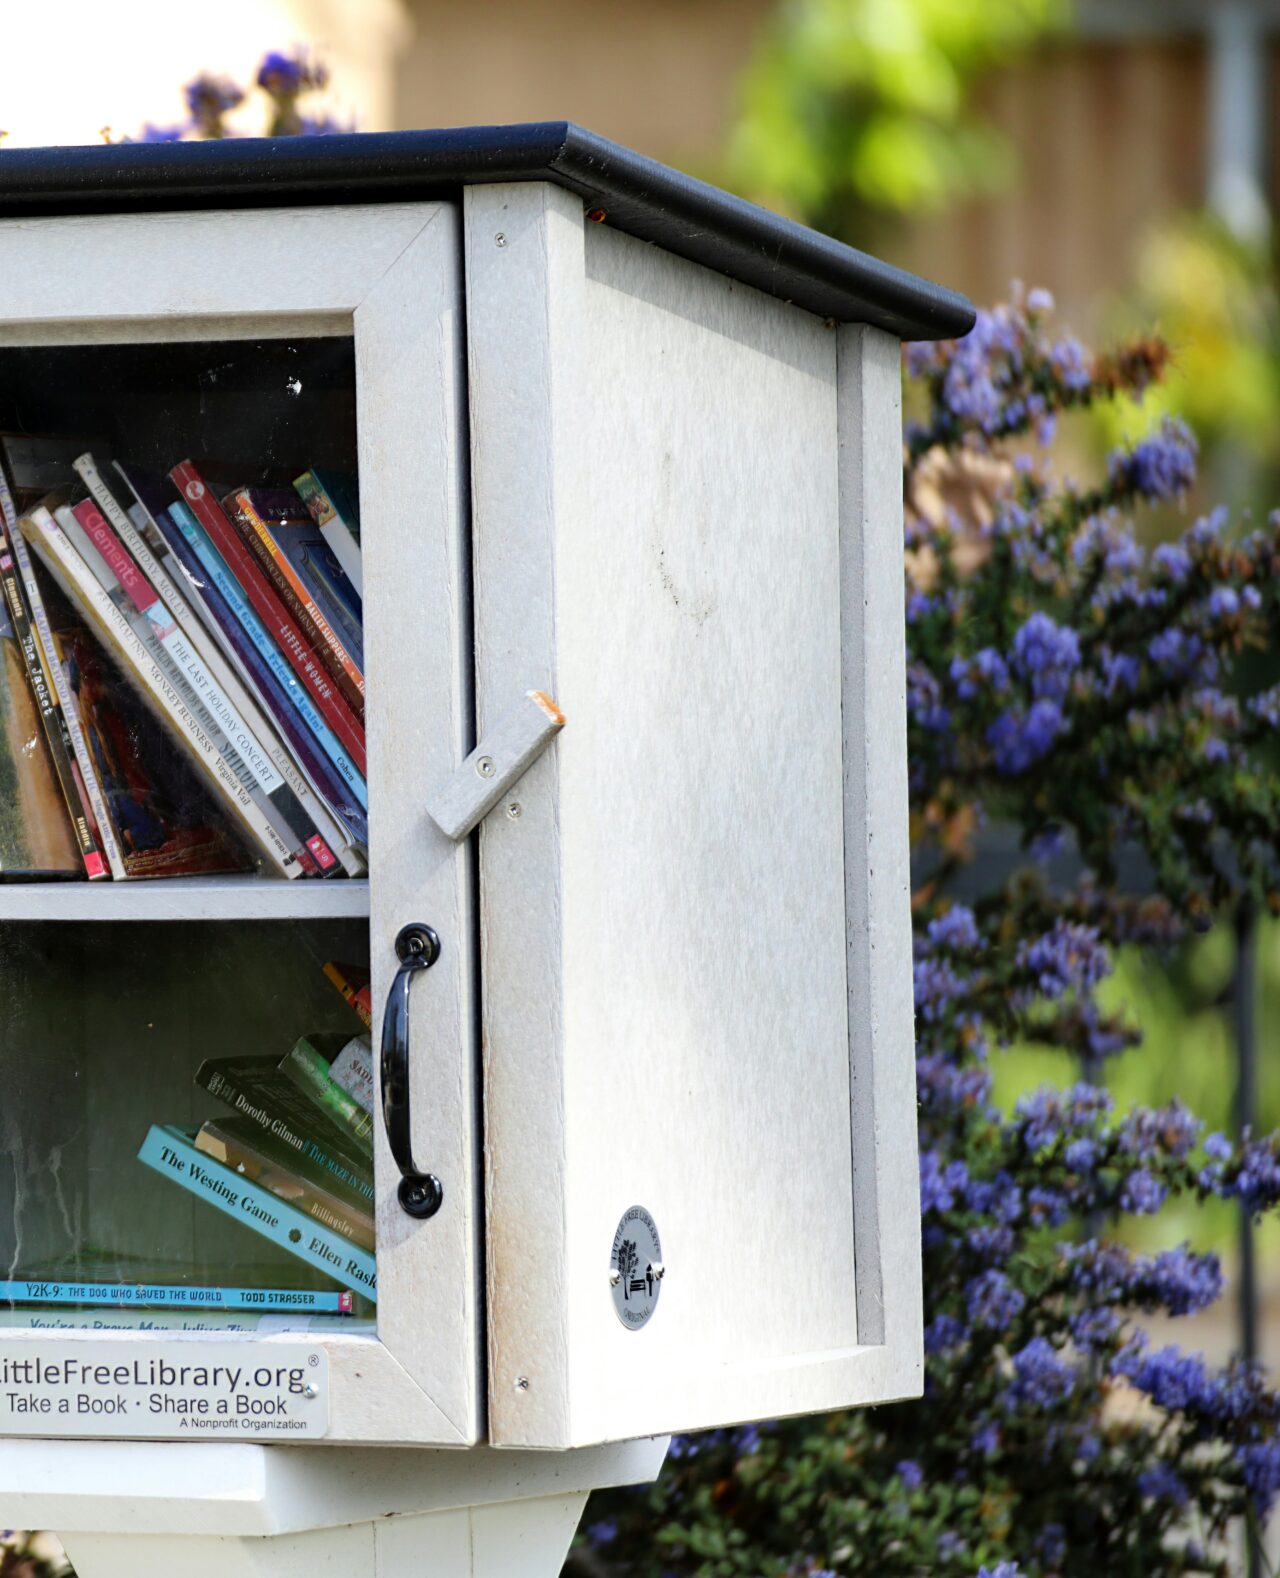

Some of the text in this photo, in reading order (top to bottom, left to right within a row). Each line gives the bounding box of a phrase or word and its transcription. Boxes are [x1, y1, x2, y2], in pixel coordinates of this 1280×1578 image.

[85, 512, 138, 587] Clements
[94, 484, 121, 521] HAPPY
[158, 578, 190, 621] MOLLY!
[6, 577, 23, 618] Clements
[248, 534, 286, 590] CHRONICLES
[283, 586, 295, 600] OF
[292, 600, 317, 638] NARNIA
[105, 601, 133, 639] ANIMAL
[129, 638, 148, 662] INN
[304, 600, 326, 629] BALLET
[23, 633, 54, 717] The Jacket
[215, 572, 242, 611] Second
[297, 694, 324, 732] Again!
[280, 624, 307, 662] LITTLE
[304, 660, 333, 698] WOMEN
[33, 605, 55, 653] TRAPPED
[69, 723, 89, 760] MAGIC
[80, 761, 98, 794] ATTIC
[149, 664, 215, 753] MONKEY BUSINESS
[171, 640, 275, 782] THE LAST HOLIDAY CONCERT
[215, 756, 252, 807] Virginia Vail
[219, 741, 261, 792] SHILOH
[272, 747, 308, 797] PLEASANT
[336, 756, 355, 782] Cohen
[76, 817, 91, 847] Aladdin
[94, 798, 106, 820] Magic
[235, 1093, 305, 1150] Dorothy Gilman
[160, 1146, 279, 1228] The Westing Game
[348, 1175, 360, 1187] IN
[311, 1202, 355, 1238] Billingsley
[622, 1208, 639, 1227] FREE
[308, 1237, 342, 1267] Ellen
[26, 1283, 222, 1301] Y2K-9: THE DOG WHO SAVED THE WORLD
[240, 1292, 315, 1304] TODD STRASSER
[6, 1393, 288, 1415] Take a Book Share a Book
[179, 1418, 307, 1431] A Nonprofit Organization
